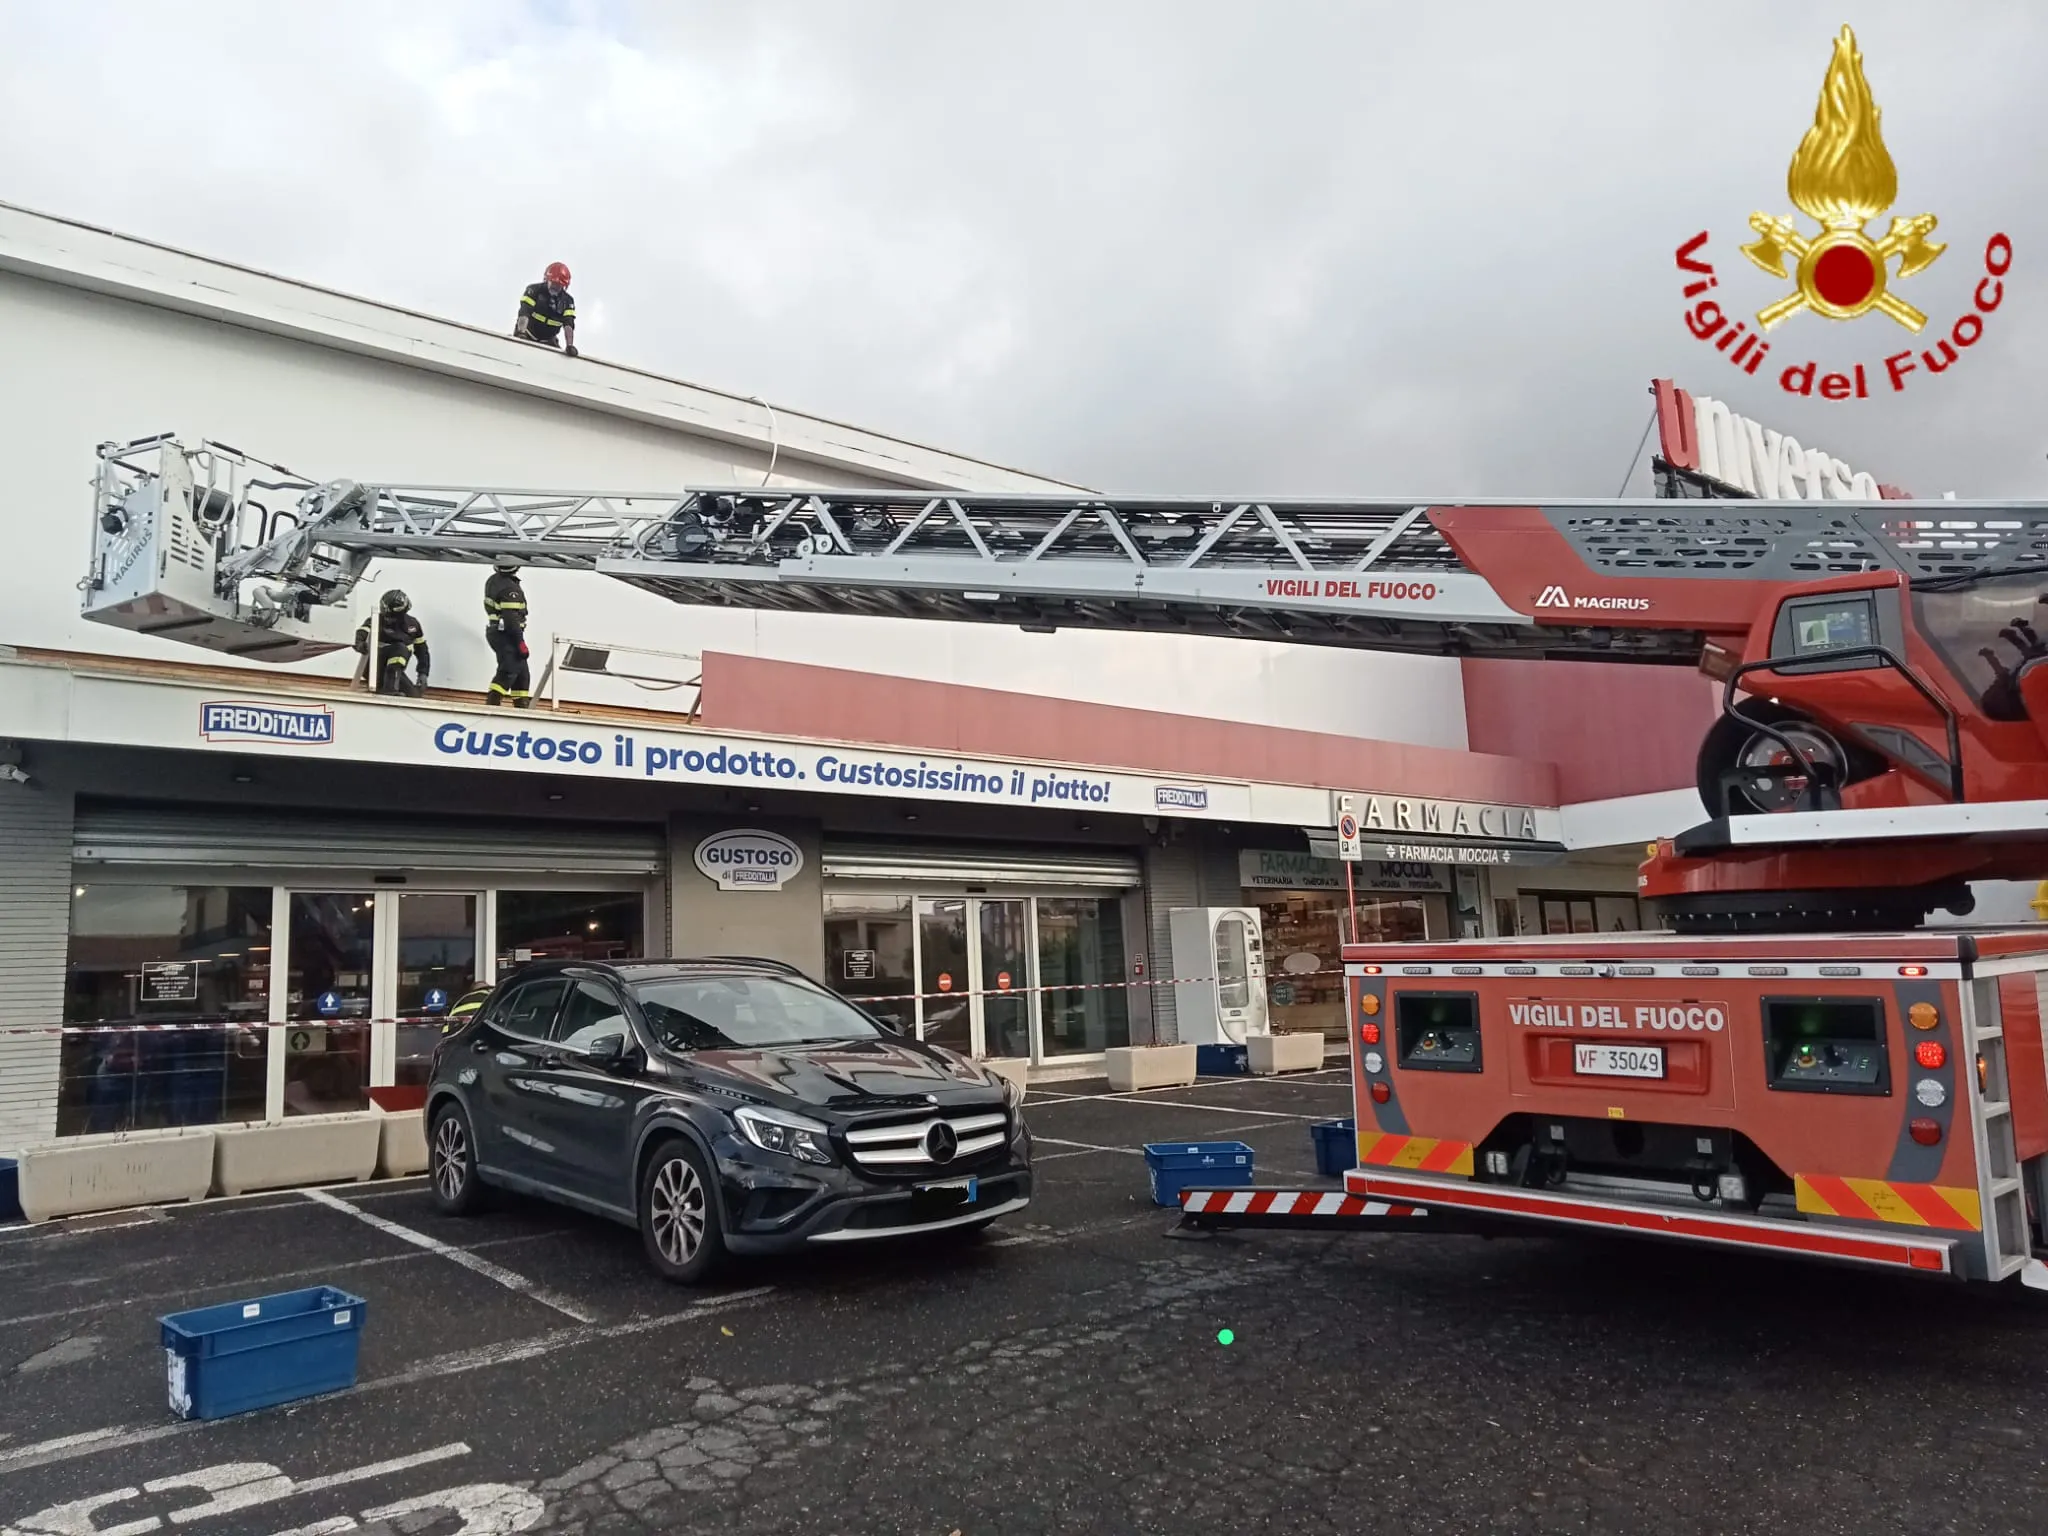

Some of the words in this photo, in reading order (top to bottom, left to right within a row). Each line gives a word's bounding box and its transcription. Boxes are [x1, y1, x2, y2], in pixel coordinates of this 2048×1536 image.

[112, 528, 152, 585] MAGIRUS
[1267, 580, 1319, 597] VIGILI
[1325, 581, 1361, 599] DEL
[1368, 582, 1436, 601] FUOCO
[1573, 596, 1650, 611] MAGIRUS
[434, 722, 602, 764] Gustoso
[615, 734, 634, 768] il
[645, 745, 806, 779] prodotto.
[815, 756, 1004, 795] Gustosissimo
[1011, 770, 1025, 795] il
[1031, 773, 1110, 803] piatto!
[1339, 795, 1538, 840] FARMACIA
[706, 847, 794, 866] GUSTOSO
[1260, 852, 1329, 875] FARMACIA
[1379, 861, 1434, 879] MOCCIA
[1399, 845, 1455, 861] FARMACIA
[1458, 848, 1499, 864] MOCCIA
[721, 869, 731, 881] di
[1508, 1004, 1574, 1028] VIGILI
[1581, 1006, 1628, 1029] DEL
[1635, 1007, 1725, 1032] FUOCO
[1579, 1050, 1597, 1069] VF
[1608, 1050, 1659, 1073] 35049
